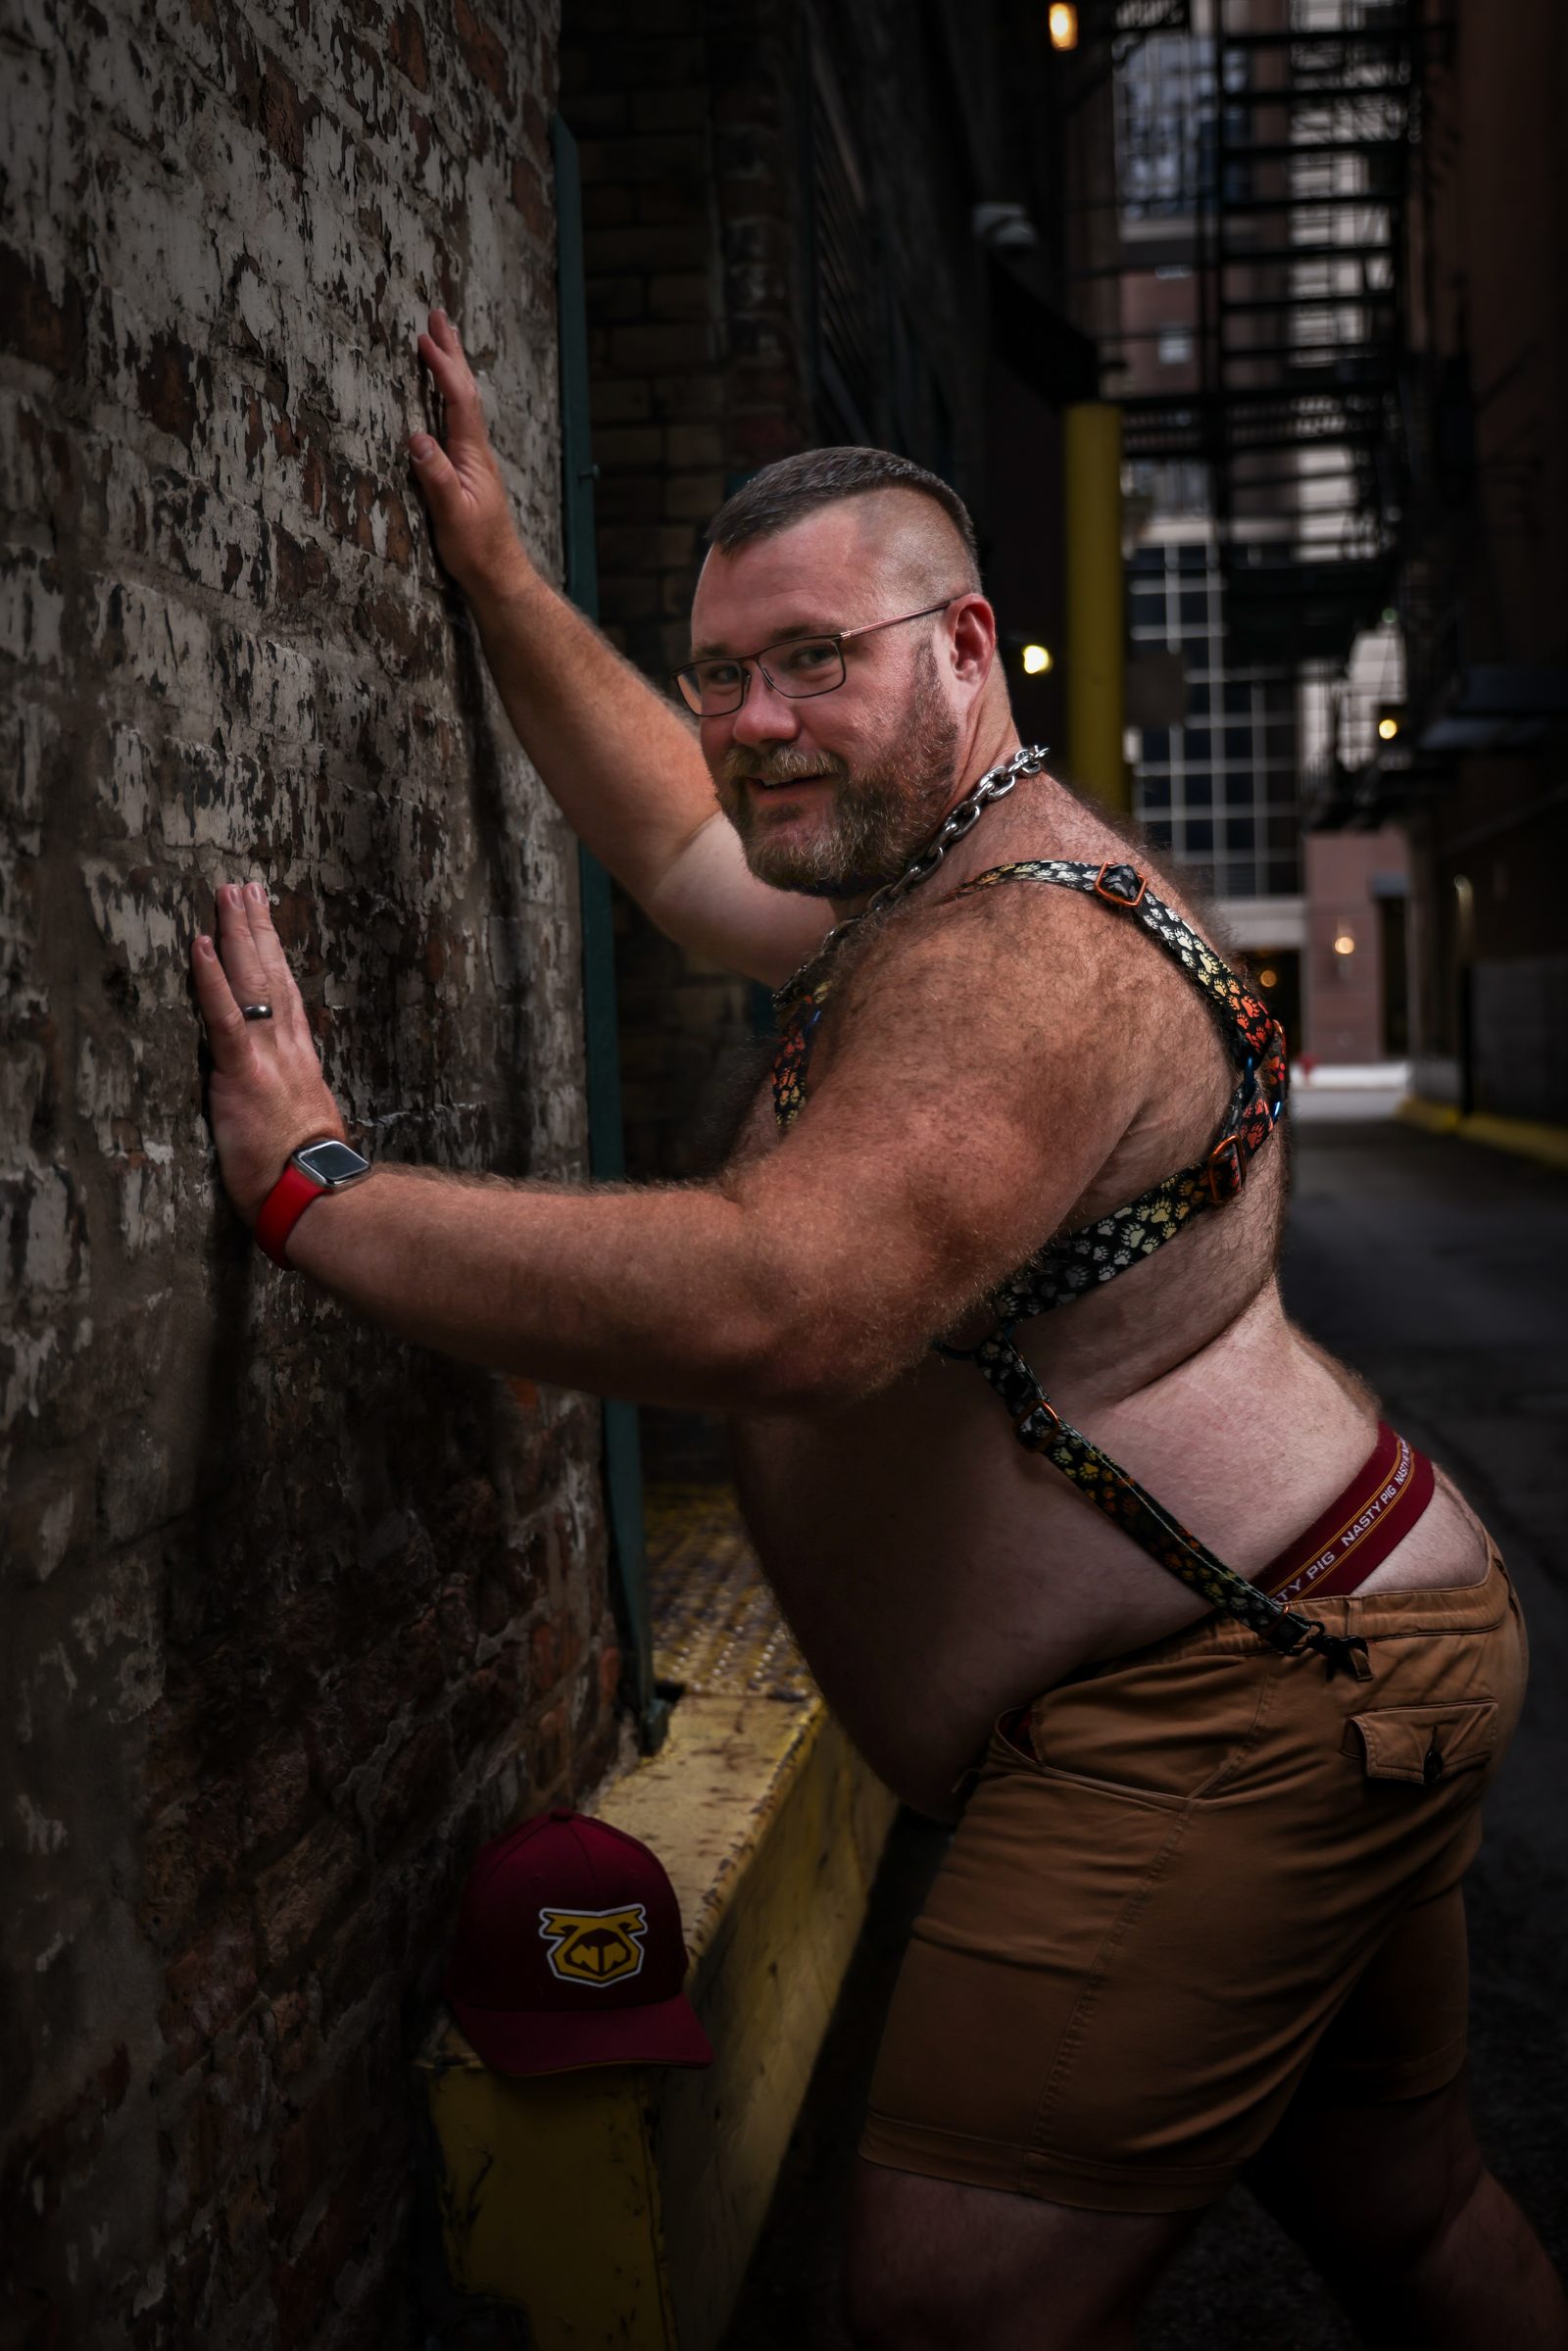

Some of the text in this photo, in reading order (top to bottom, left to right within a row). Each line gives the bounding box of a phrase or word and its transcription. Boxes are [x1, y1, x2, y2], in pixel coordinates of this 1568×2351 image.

[1306, 1551, 1336, 1580] PIG
[1341, 1501, 1381, 1546] NASTY
[1380, 1485, 1396, 1504] PIG
